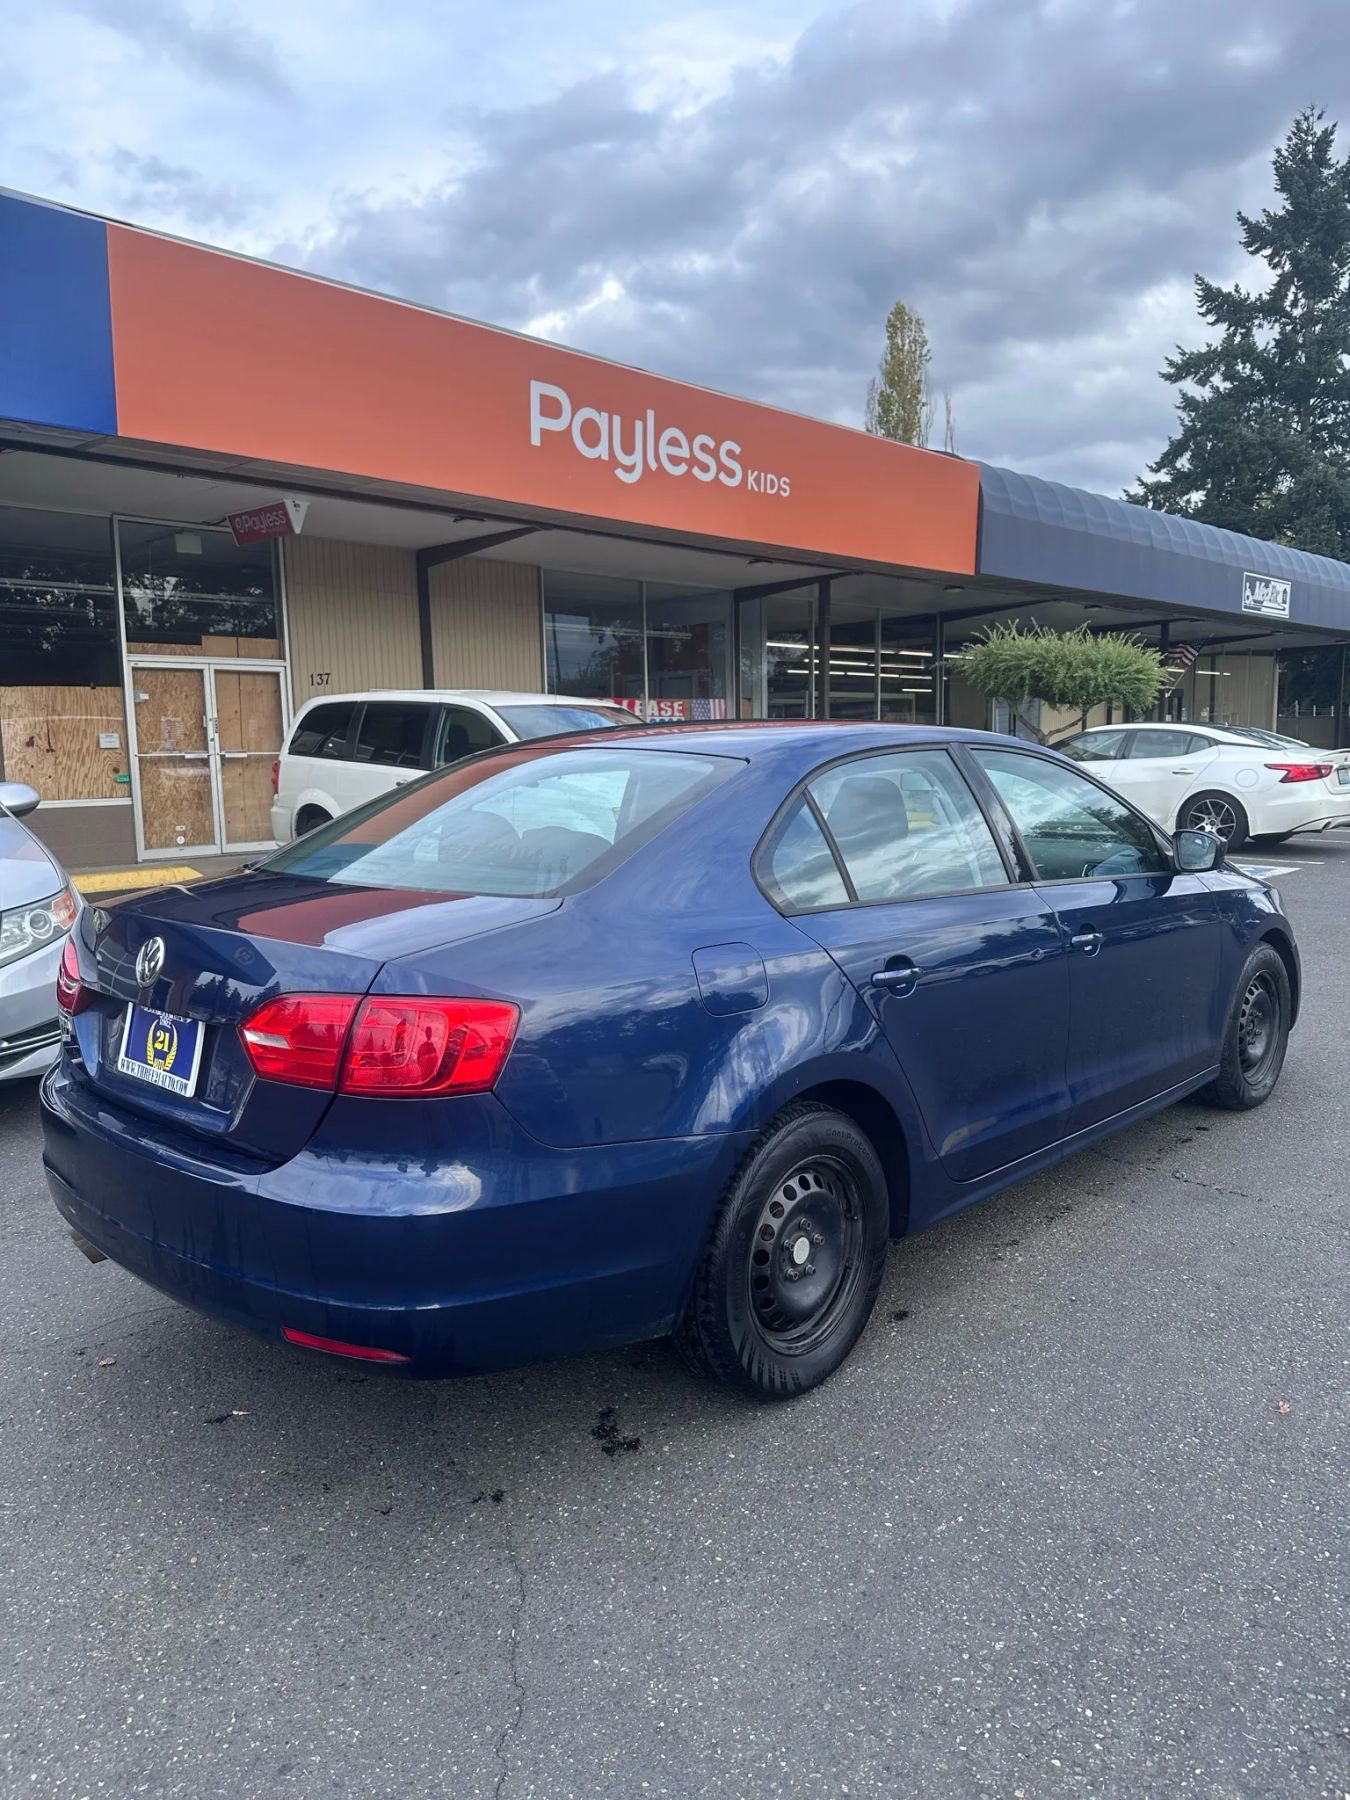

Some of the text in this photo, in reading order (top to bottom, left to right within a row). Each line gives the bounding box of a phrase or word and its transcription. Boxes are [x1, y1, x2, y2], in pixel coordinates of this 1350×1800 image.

[529, 379, 791, 497] Payless KIDS
[242, 510, 287, 533] Payless
[310, 672, 332, 686] 137
[154, 1029, 169, 1053] 21
